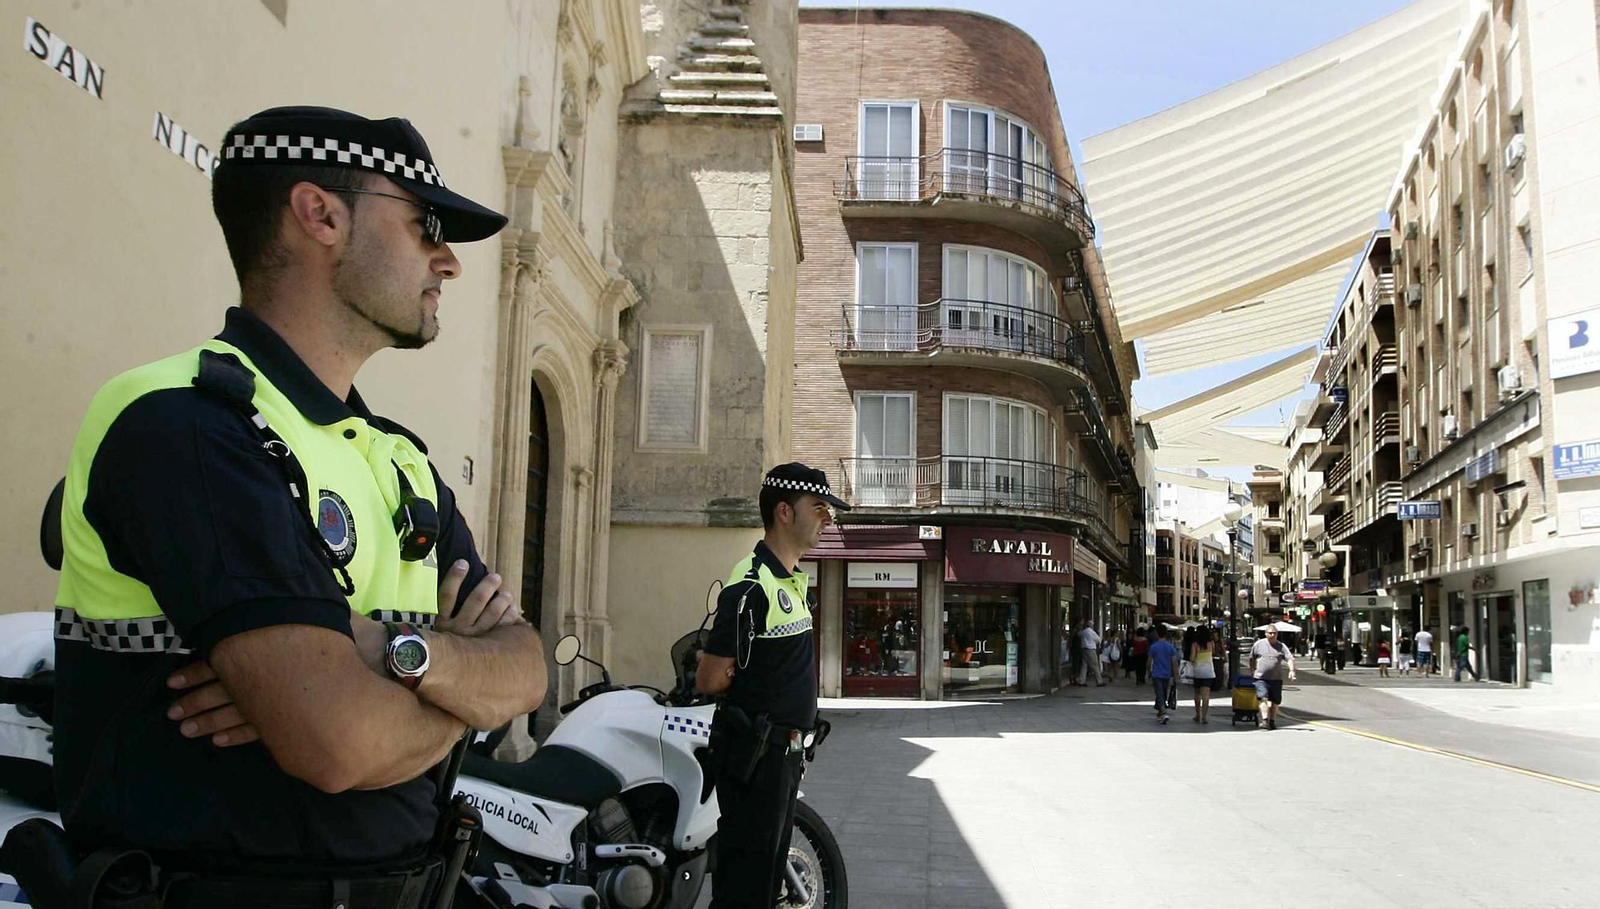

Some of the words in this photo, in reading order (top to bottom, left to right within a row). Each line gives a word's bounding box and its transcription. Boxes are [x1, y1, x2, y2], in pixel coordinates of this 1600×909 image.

[29, 22, 105, 99] SAN
[971, 538, 1052, 556] RAFAEL
[1028, 558, 1070, 574] MILLA
[874, 572, 891, 581] RM
[507, 809, 539, 835] LOCAL
